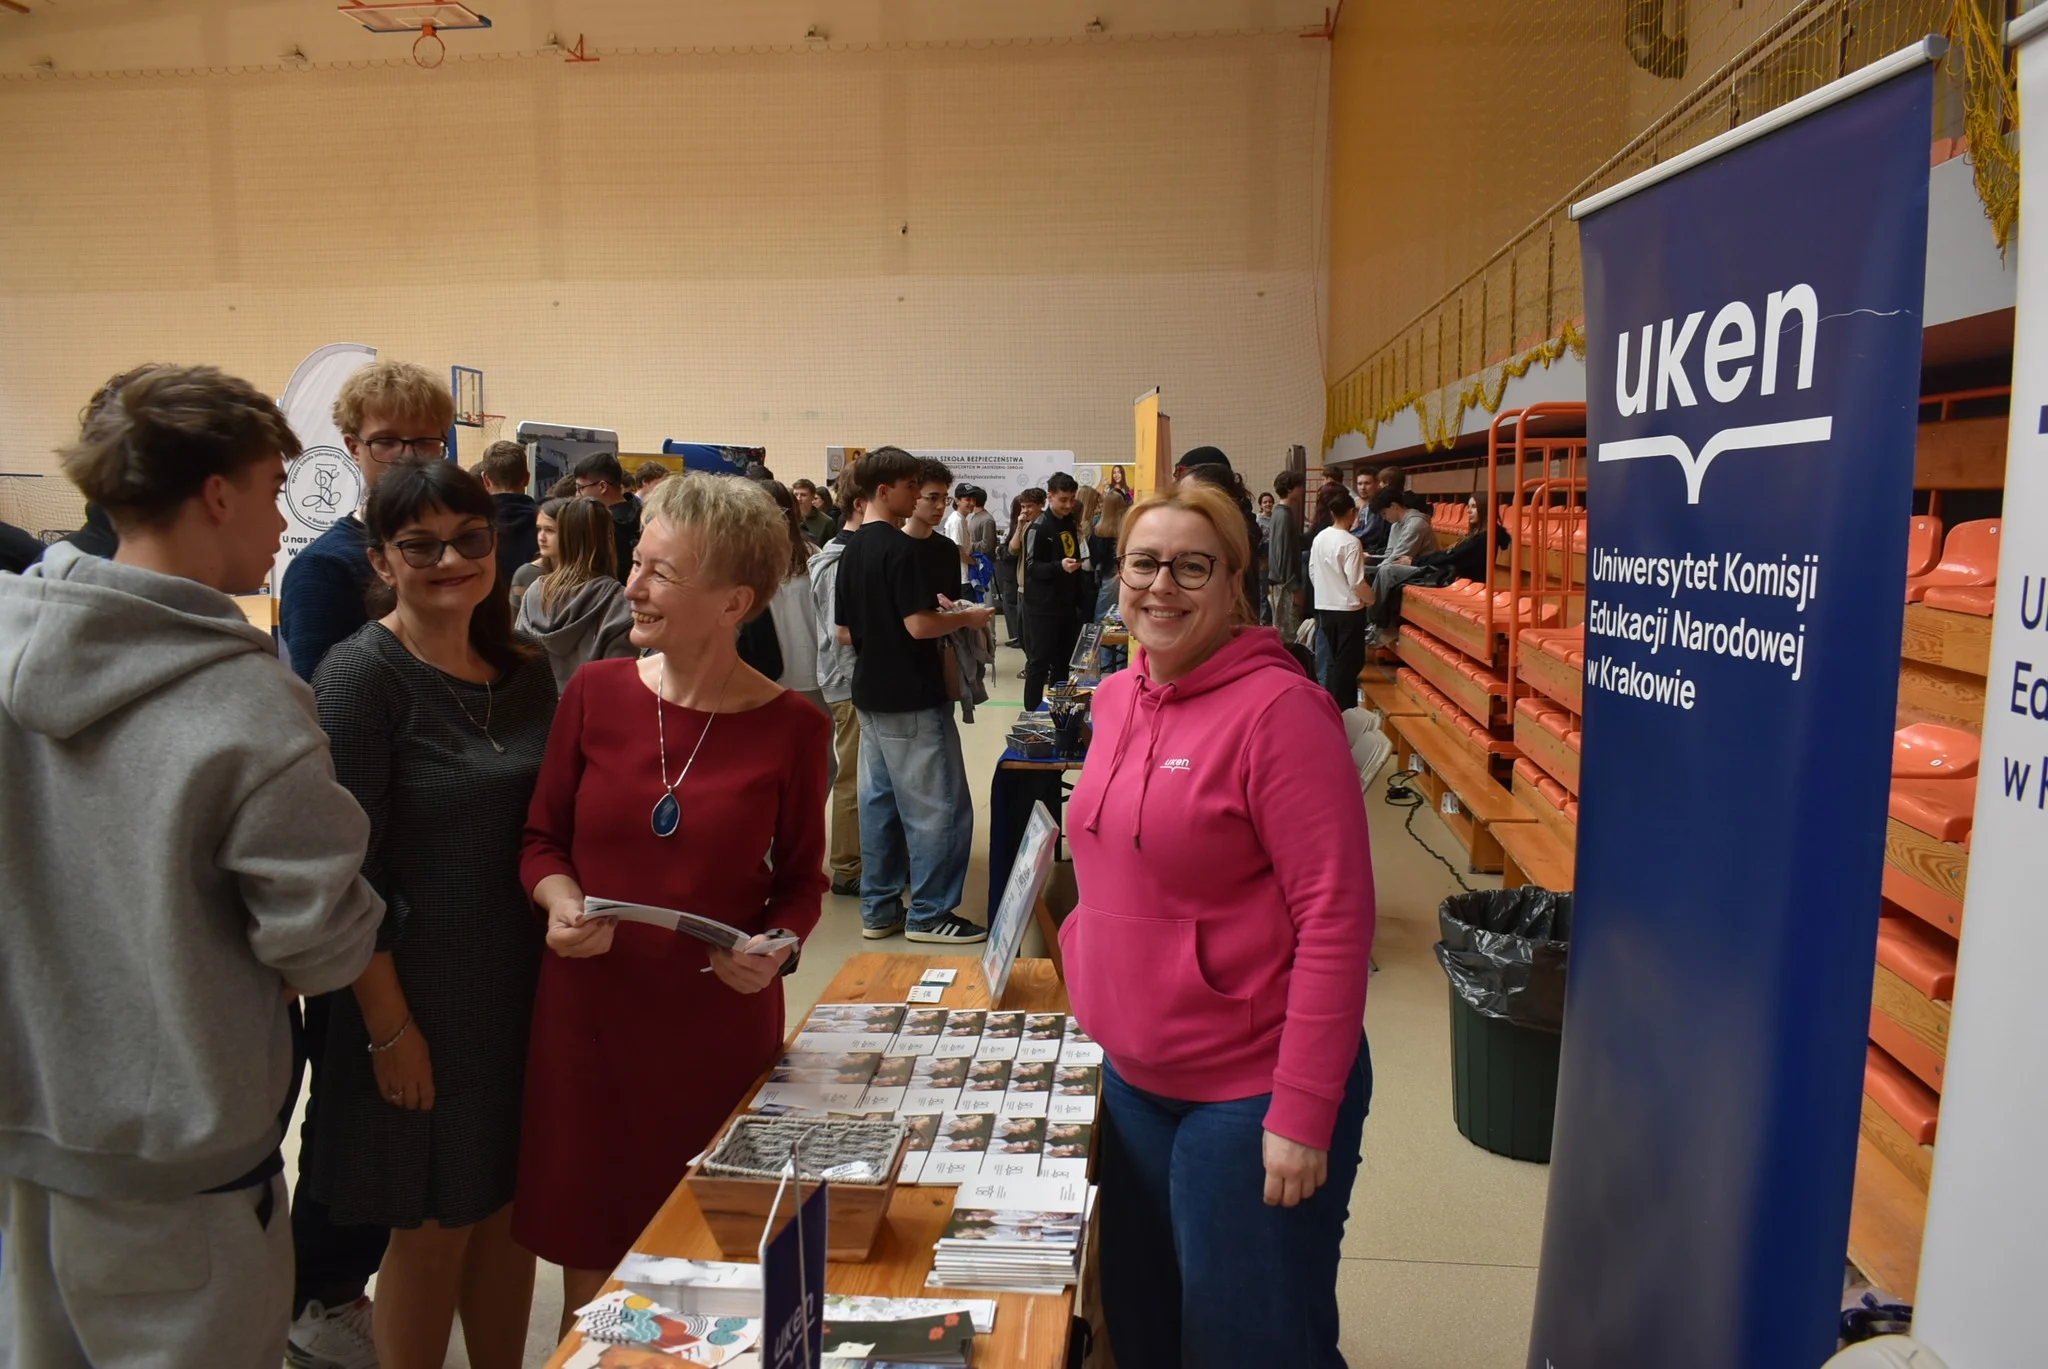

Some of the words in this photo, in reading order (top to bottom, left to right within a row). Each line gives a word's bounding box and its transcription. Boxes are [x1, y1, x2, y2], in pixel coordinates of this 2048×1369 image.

[1616, 283, 1819, 417] uken
[967, 454, 1024, 463] BEZPIECZEŃSTWA
[282, 535, 289, 543] U
[1592, 547, 1719, 599] Uniwersytet
[1723, 552, 1819, 612] Komisji
[2021, 575, 2048, 632] U
[1589, 599, 1669, 655] Edukacji
[1671, 609, 1805, 681] Narodowej
[1587, 658, 1599, 686] w
[1599, 655, 1696, 710] Krakowie
[1164, 758, 1190, 767] uken
[2003, 755, 2032, 803] w
[774, 1292, 814, 1361] uken
